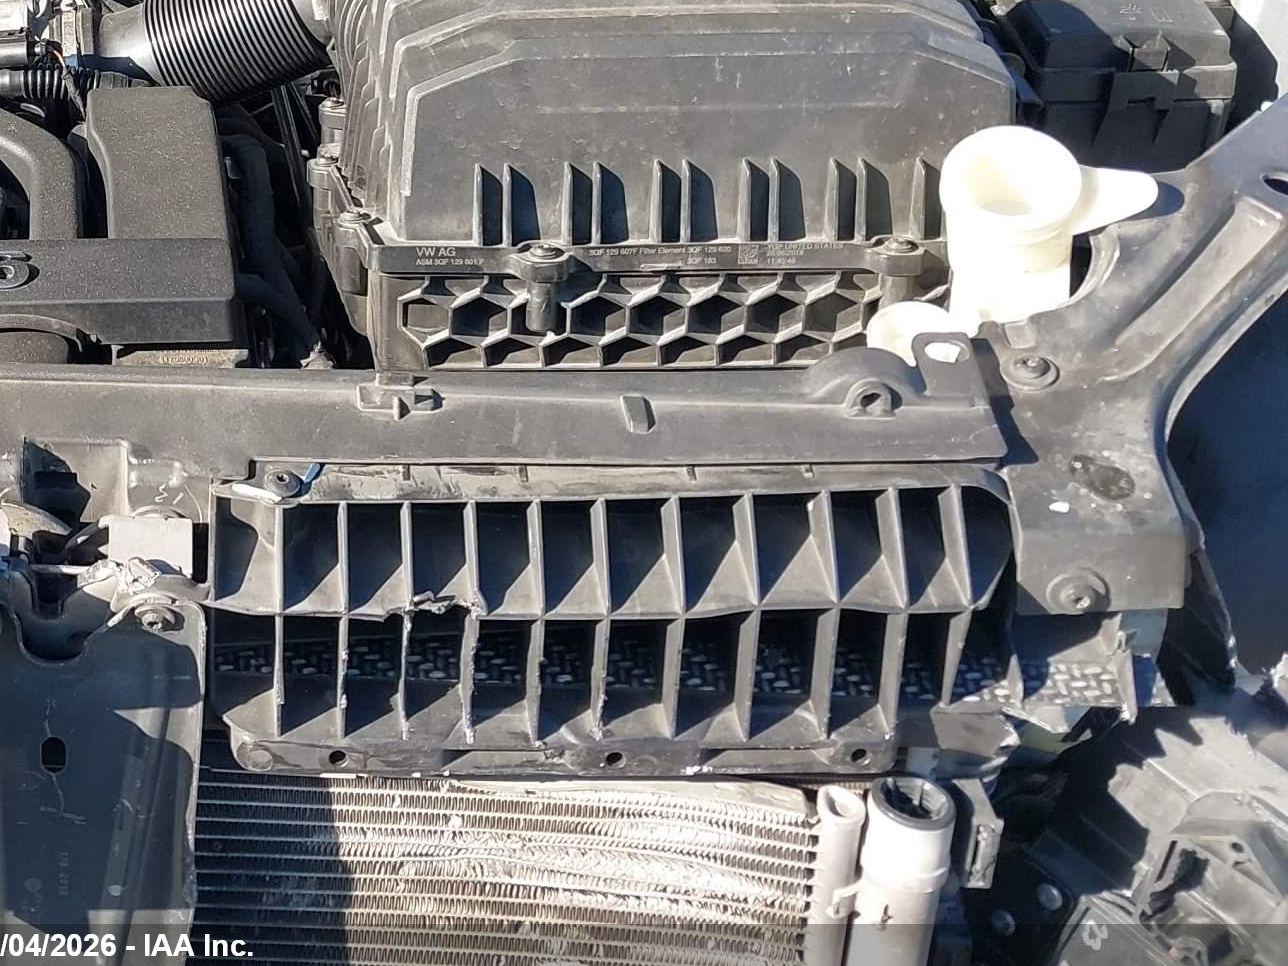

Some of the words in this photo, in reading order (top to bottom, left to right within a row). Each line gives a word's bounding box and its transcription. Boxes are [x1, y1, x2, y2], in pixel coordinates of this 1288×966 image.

[416, 247, 435, 257] VW
[438, 247, 456, 257] AG
[639, 247, 656, 255] Filter
[657, 246, 685, 254] Element
[686, 257, 702, 265] 3QF
